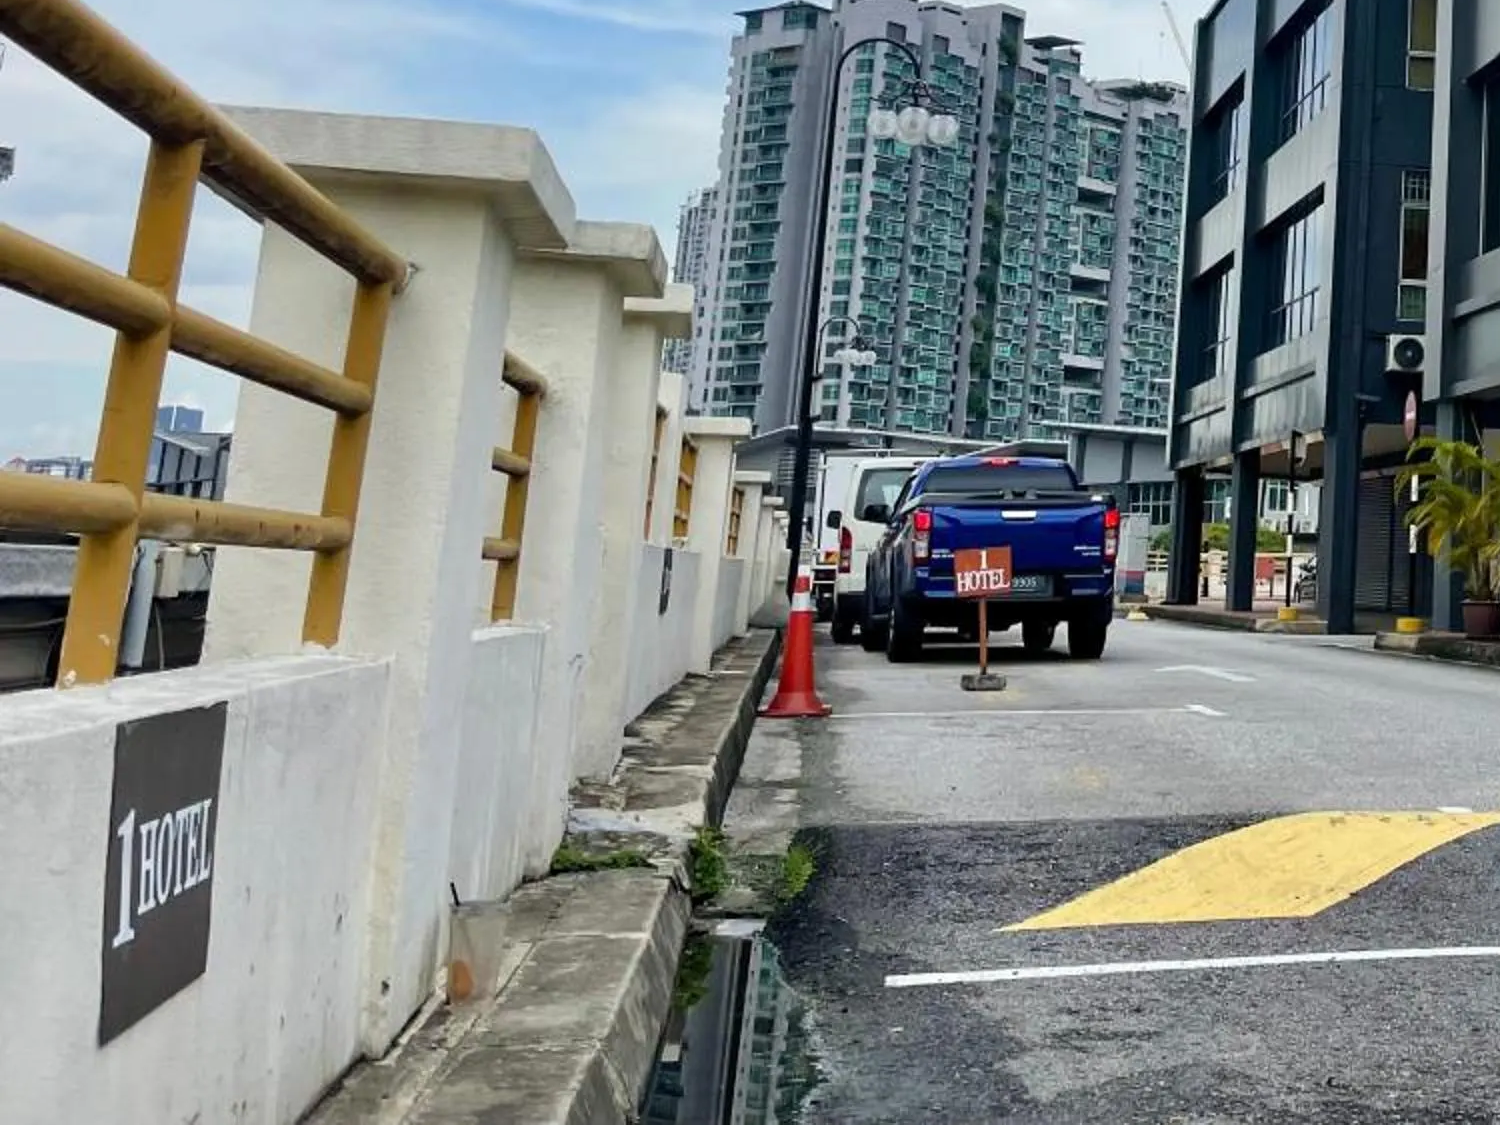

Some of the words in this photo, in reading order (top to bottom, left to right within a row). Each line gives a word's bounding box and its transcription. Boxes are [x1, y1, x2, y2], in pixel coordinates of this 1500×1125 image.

[980, 550, 988, 569] 1
[957, 569, 1011, 592] HOTEL
[113, 809, 136, 948] 1
[138, 798, 212, 916] HOTEL
